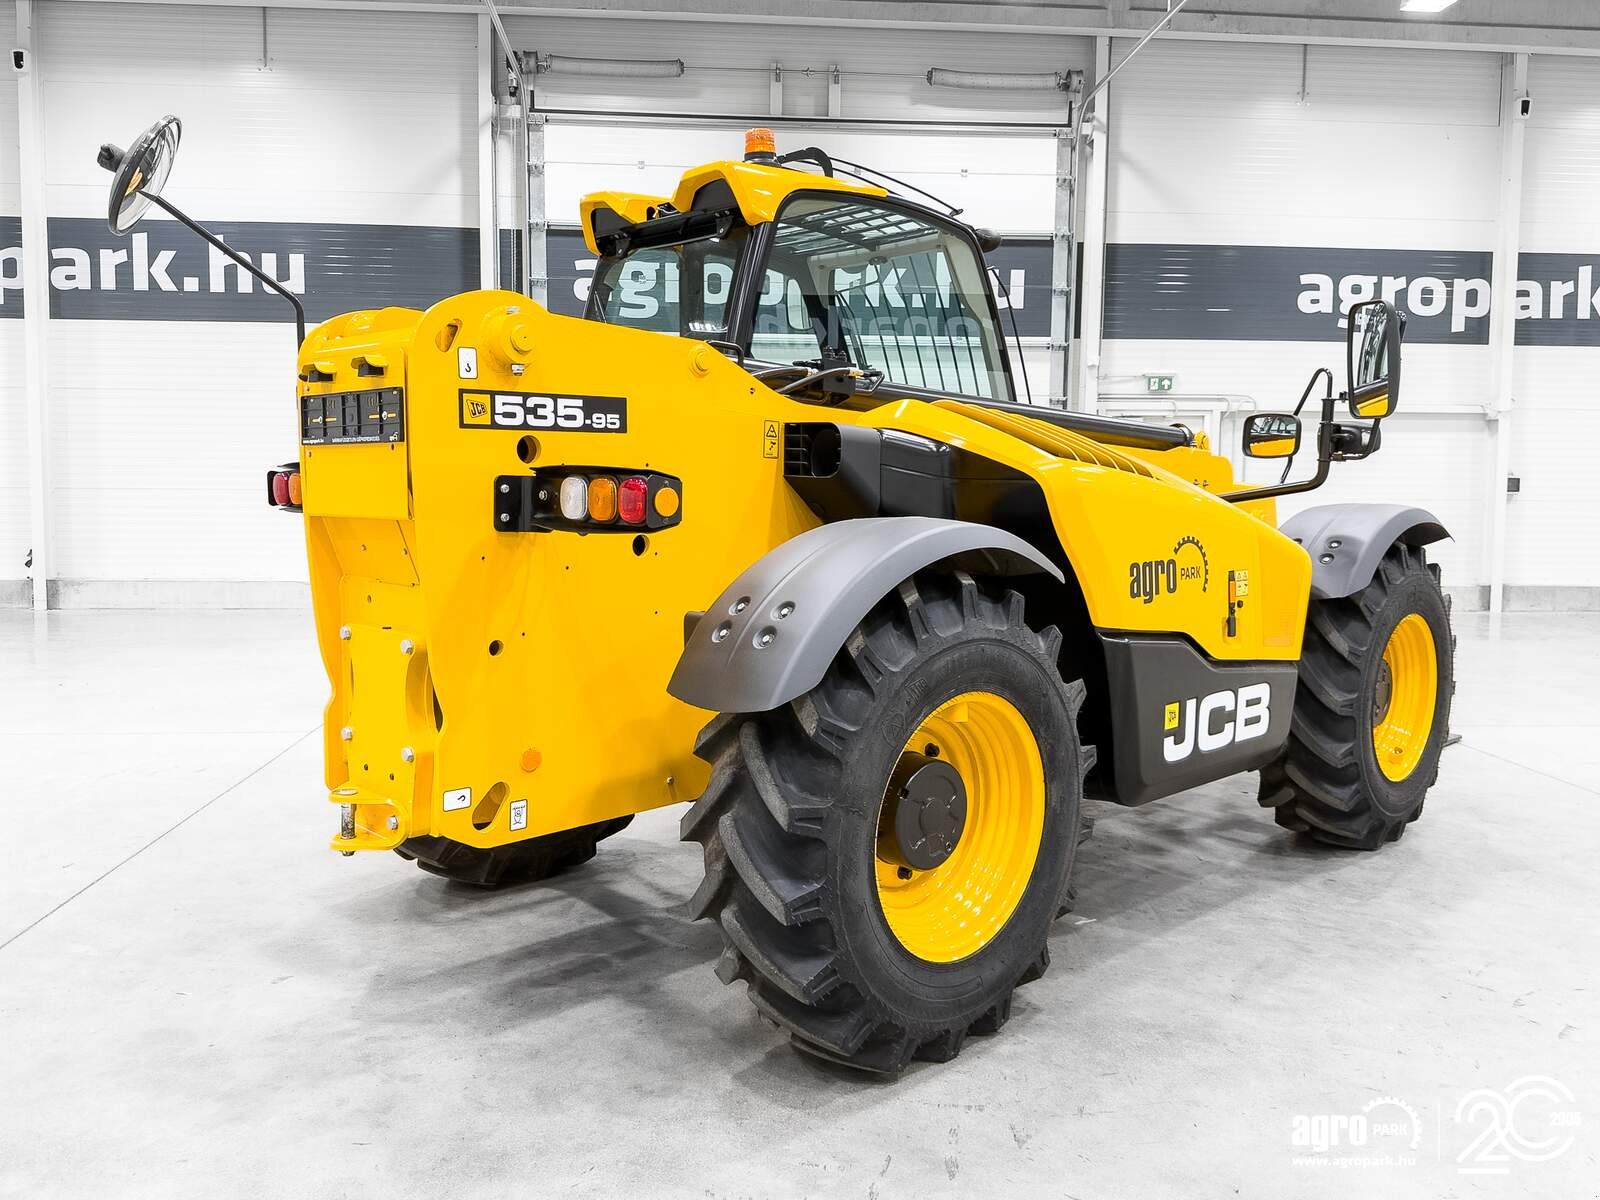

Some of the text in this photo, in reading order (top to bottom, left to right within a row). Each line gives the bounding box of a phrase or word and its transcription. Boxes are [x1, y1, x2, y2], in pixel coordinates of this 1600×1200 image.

[470, 394, 620, 429] JCB 535-95
[1129, 558, 1201, 604] agro PARK
[1163, 682, 1271, 762] JCB
